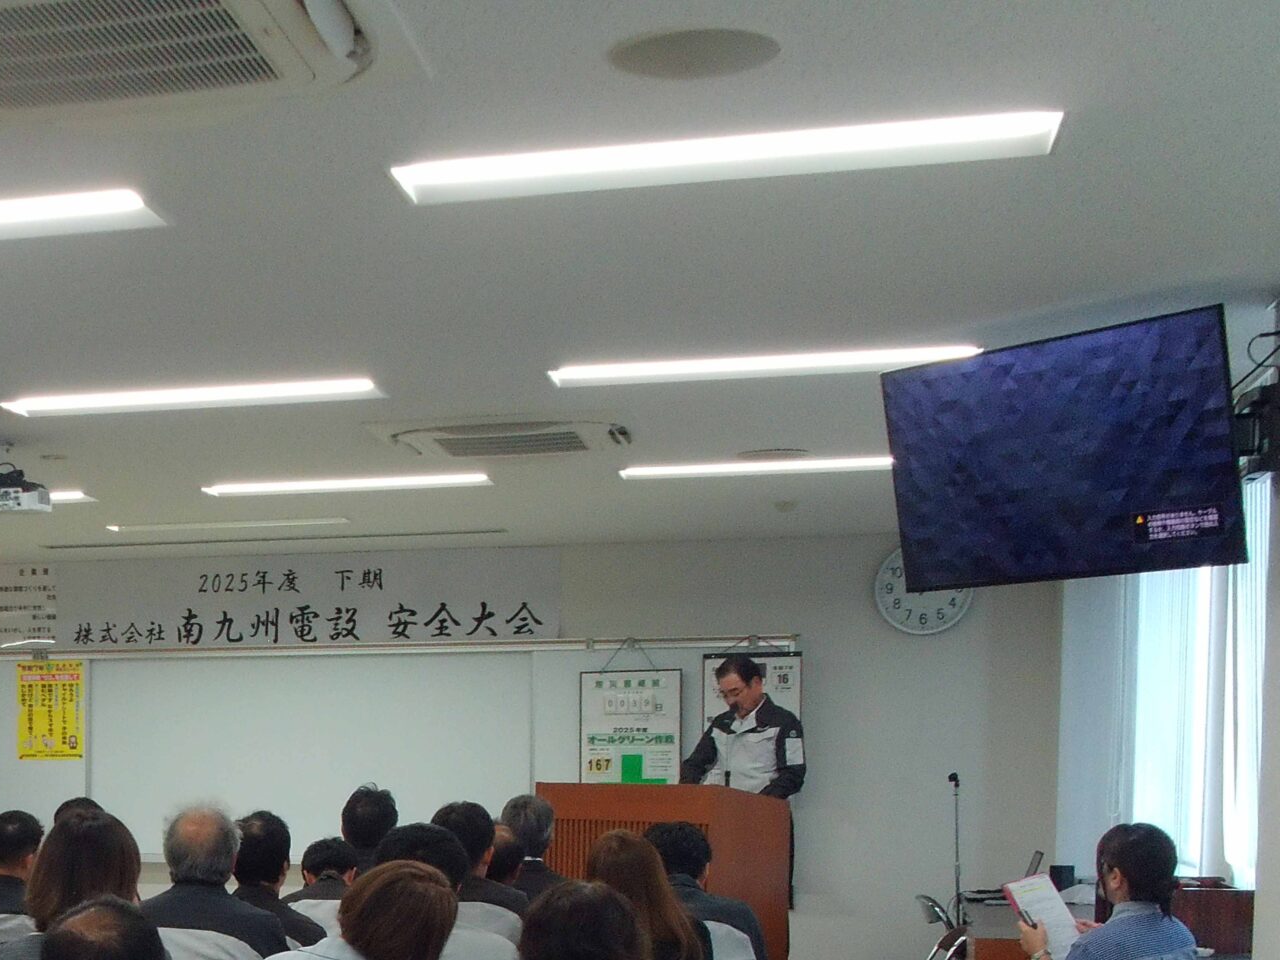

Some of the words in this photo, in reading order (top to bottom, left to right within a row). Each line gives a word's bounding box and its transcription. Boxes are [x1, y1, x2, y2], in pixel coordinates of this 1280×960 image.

[198, 568, 301, 594] 2025年度
[334, 568, 385, 591] 下期
[885, 583, 894, 595] 9
[893, 598, 901, 610] 8
[948, 597, 957, 609] 4
[386, 601, 545, 640] 安全大会
[904, 608, 913, 621] 7
[919, 613, 928, 625] 6
[936, 608, 945, 621] 5
[777, 673, 789, 684] 16
[587, 758, 612, 772] 167
